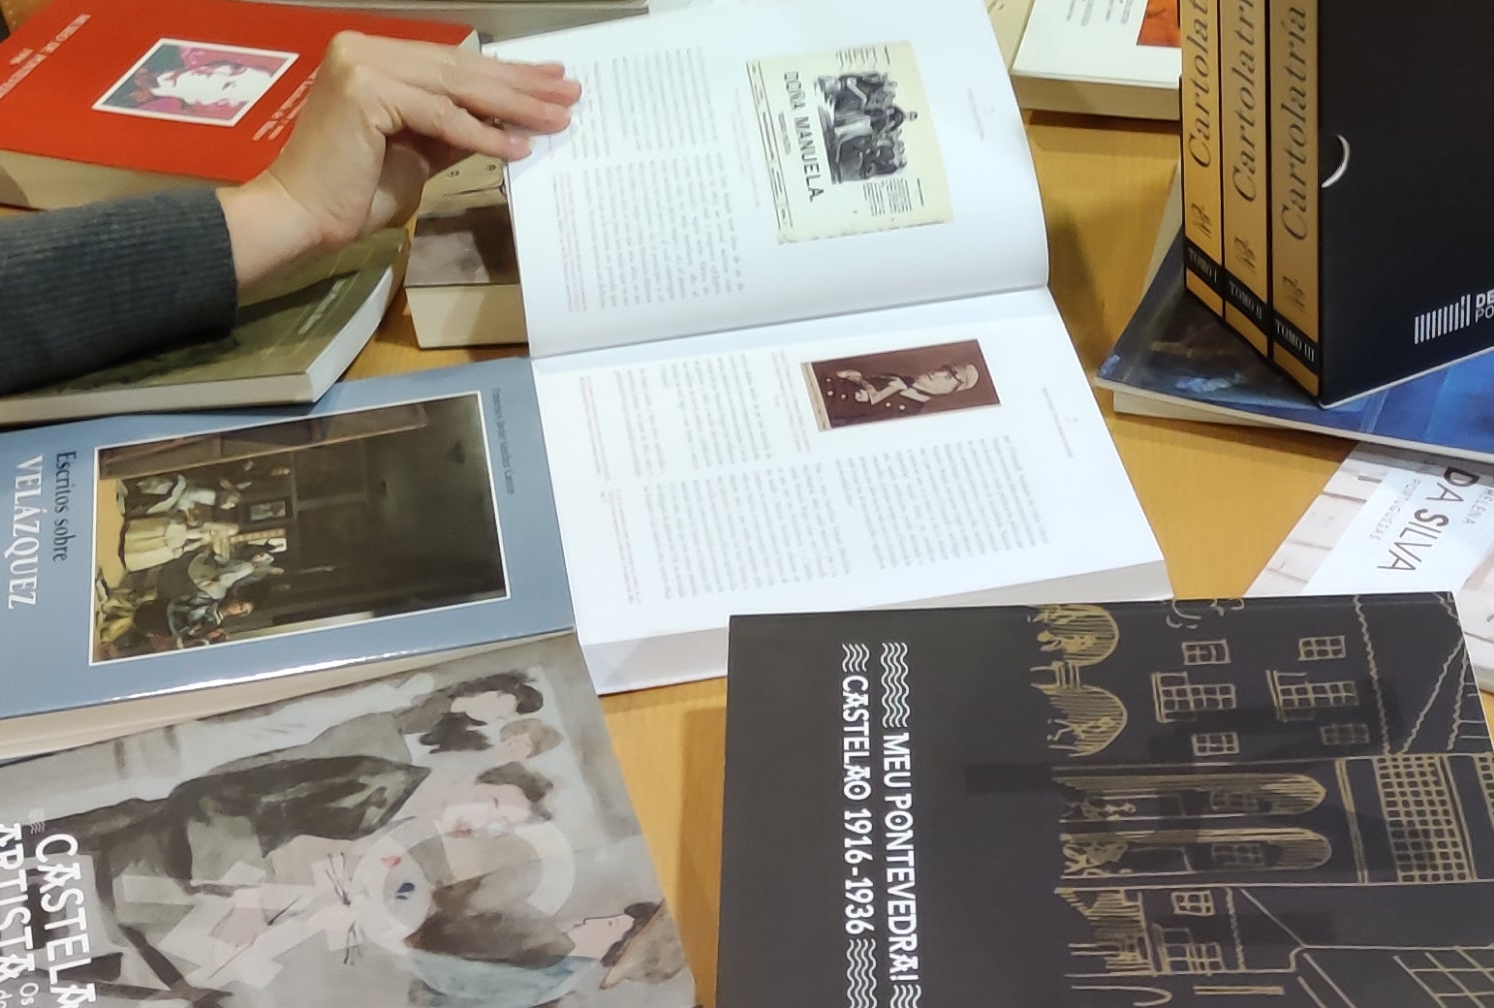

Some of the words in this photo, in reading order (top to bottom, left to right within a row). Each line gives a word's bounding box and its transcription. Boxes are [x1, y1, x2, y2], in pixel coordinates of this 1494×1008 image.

[1280, 6, 1307, 240] Cartolatría
[1188, 248, 1212, 278] TOMO
[1229, 281, 1255, 312] TOMO
[1274, 318, 1302, 350] TOMO
[1304, 343, 1315, 362] III
[54, 450, 77, 514] Escritos
[1425, 467, 1480, 502] DA
[3, 455, 48, 610] VELÁZQUEZ
[52, 520, 76, 562] sobre
[1376, 508, 1449, 571] SILVA
[841, 675, 872, 801] CASTELAO
[882, 732, 911, 788] MEU
[843, 809, 874, 934] 1916-1936
[884, 793, 919, 982] PONTEVEDRA!
[19, 982, 39, 1006] Os
